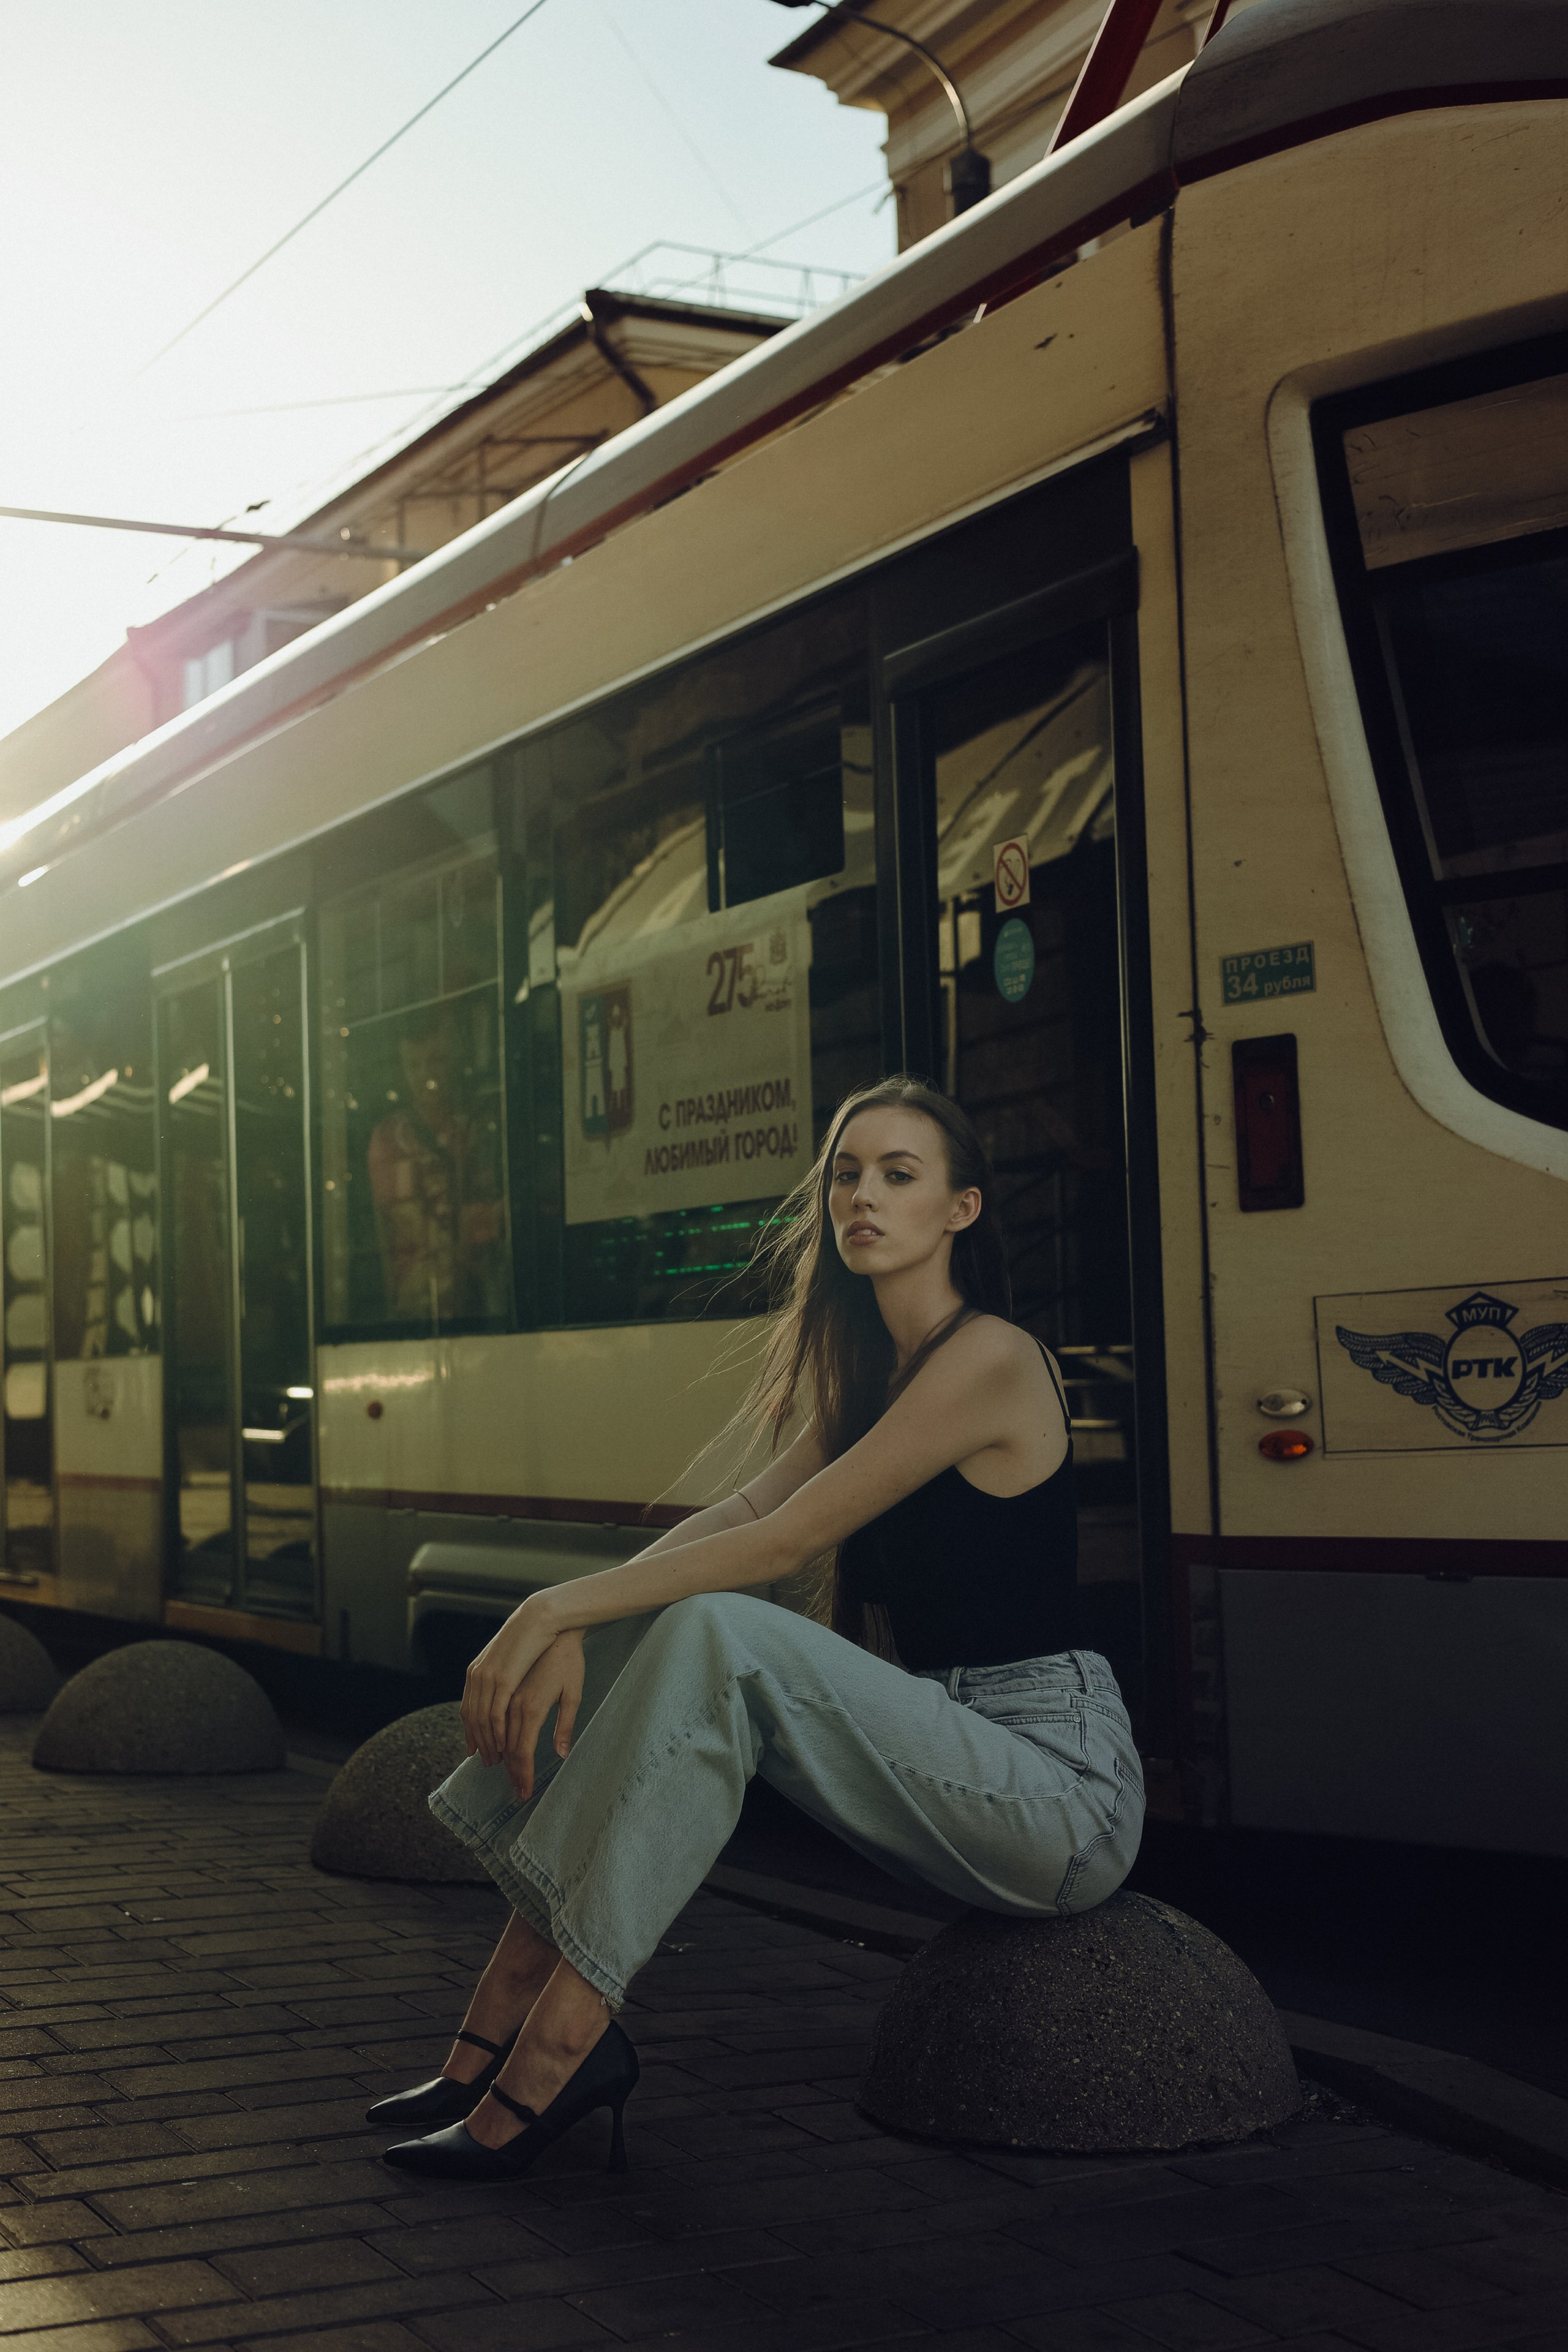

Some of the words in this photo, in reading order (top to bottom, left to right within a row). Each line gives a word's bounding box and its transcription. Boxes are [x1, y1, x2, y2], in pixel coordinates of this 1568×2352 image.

[1226, 945, 1310, 973] ПРОЕЗД
[706, 944, 756, 1016] 275
[1227, 972, 1259, 999] 34
[1264, 975, 1311, 997] рубля
[658, 1102, 671, 1131] С
[675, 1077, 796, 1128] ПРАЗДНИКОМ,
[643, 1128, 731, 1176] ЛЮБИМЫЙ
[735, 1123, 798, 1159] ГОРОД!
[1461, 1306, 1501, 1323] МУП
[1451, 1355, 1518, 1380] РТК
